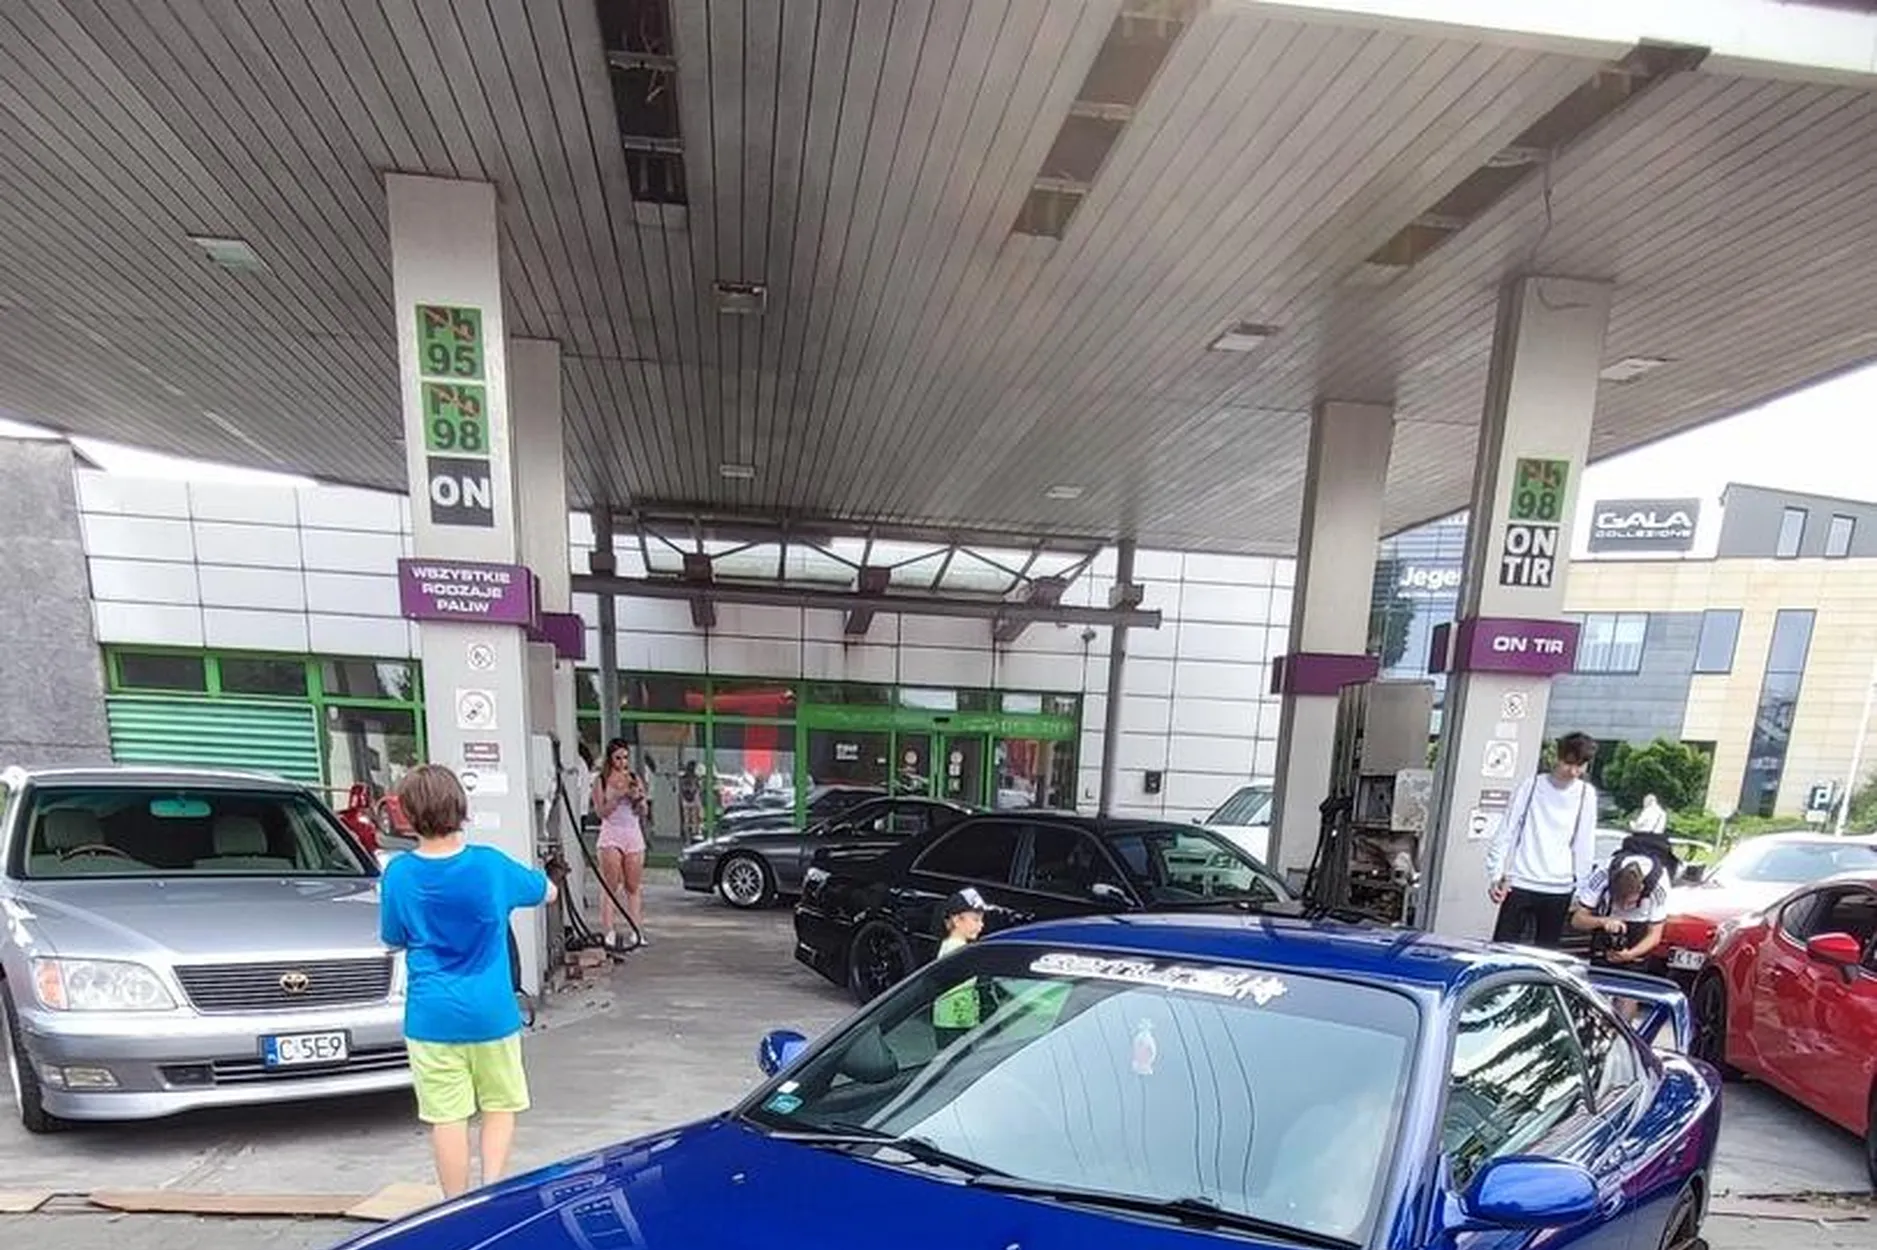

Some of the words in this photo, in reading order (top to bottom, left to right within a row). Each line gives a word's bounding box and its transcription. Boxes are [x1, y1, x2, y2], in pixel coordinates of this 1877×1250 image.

[427, 343, 477, 377] 95
[433, 418, 482, 451] 98
[430, 474, 493, 509] ON
[1517, 490, 1556, 520] 98
[1596, 511, 1693, 529] GALA
[1506, 526, 1557, 556] ON
[411, 566, 511, 584] WSZYSTKIE
[1399, 566, 1461, 590] Jege
[1503, 556, 1551, 585] TIR
[421, 582, 504, 599] RODZAJE
[436, 599, 490, 613] PALIW
[1493, 636, 1528, 652] ON
[1533, 637, 1564, 654] TIR
[301, 1036, 342, 1059] 5E9
